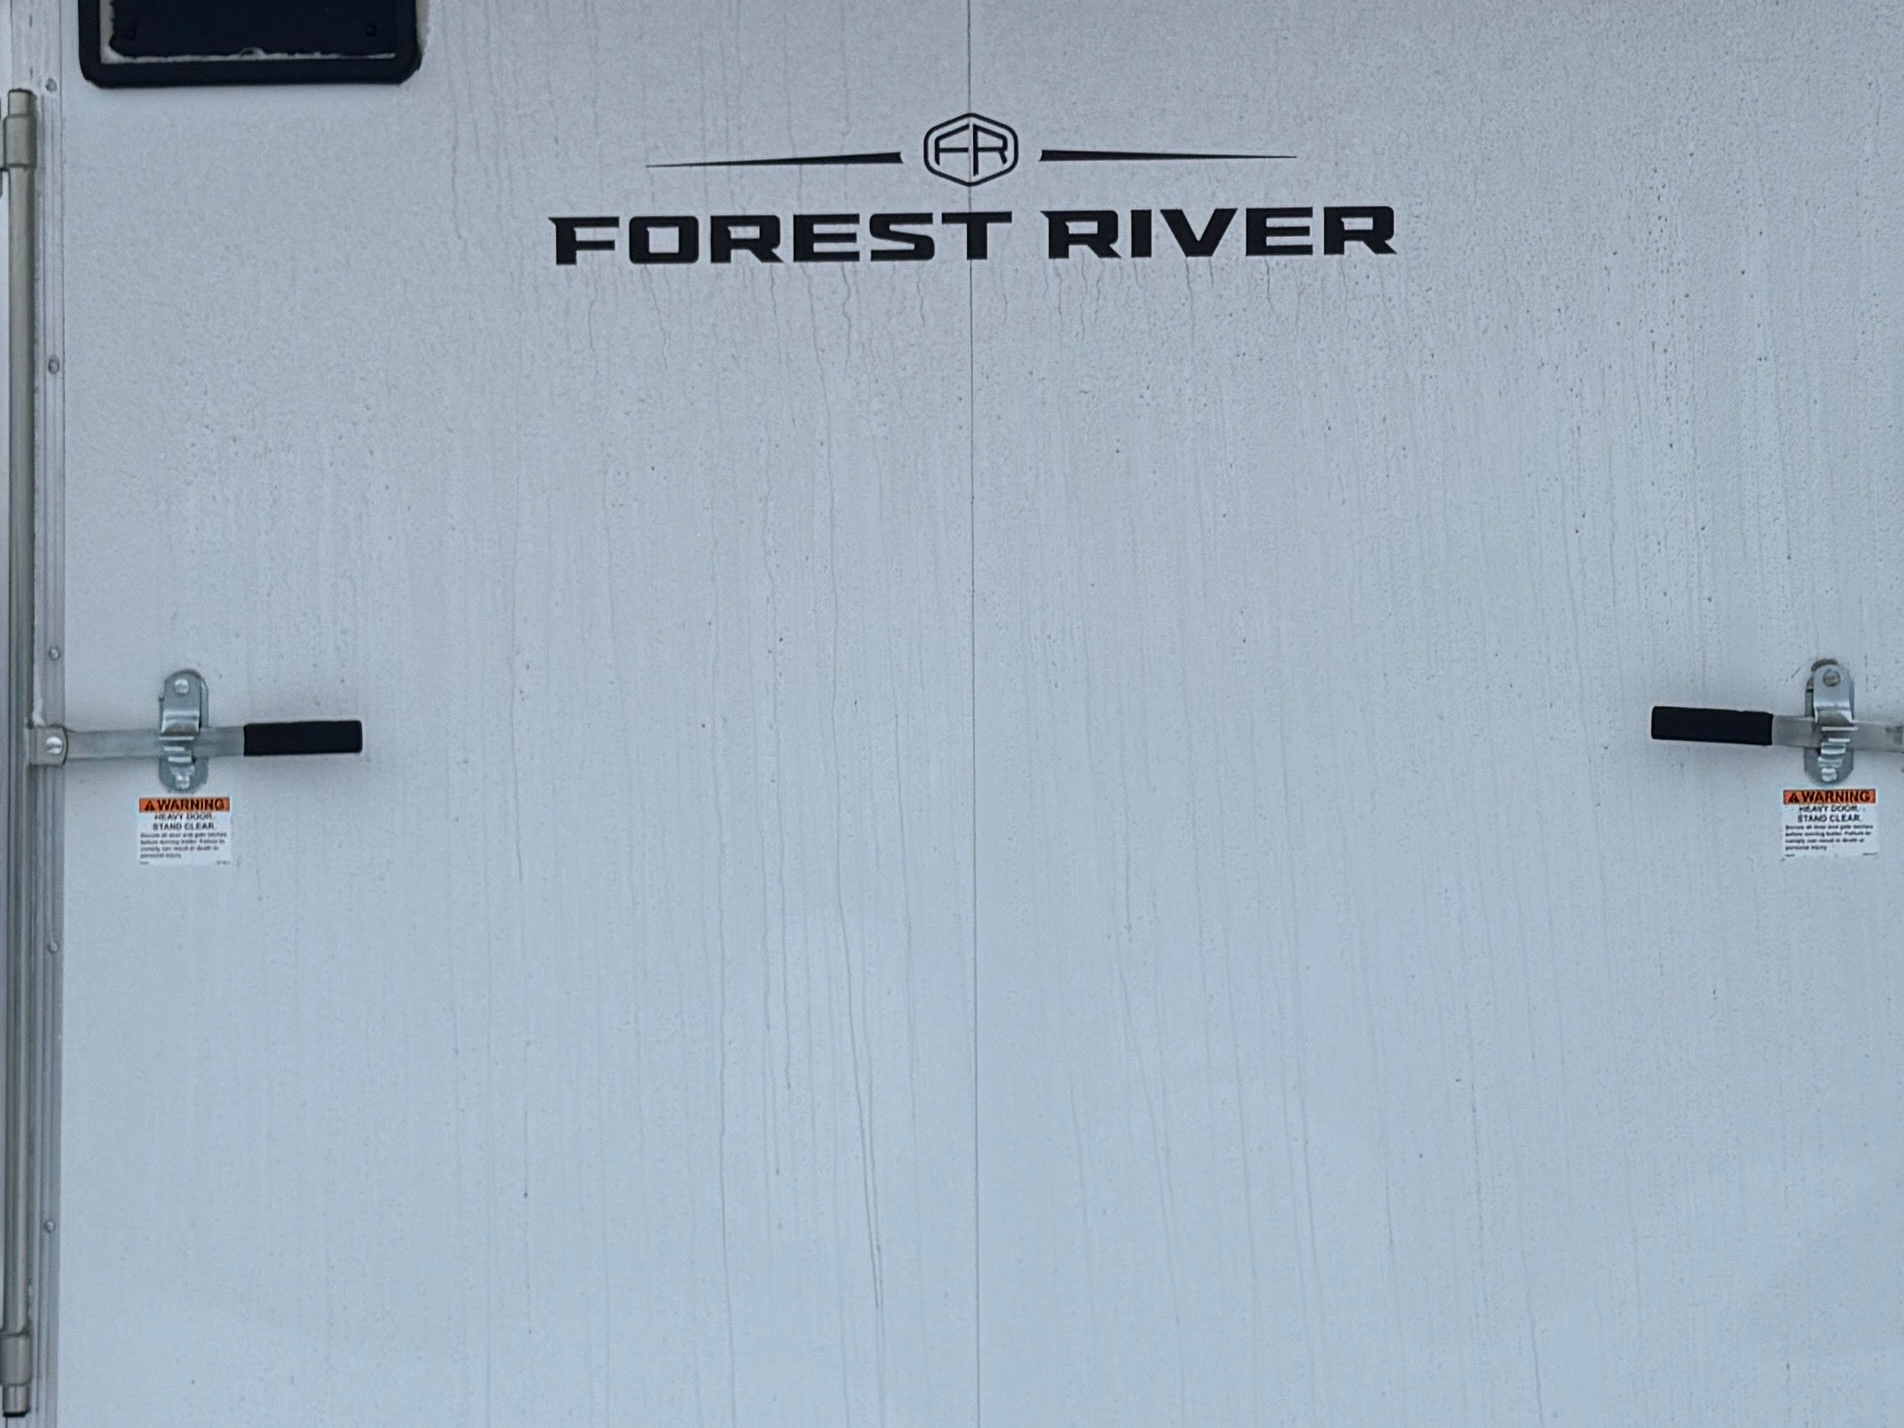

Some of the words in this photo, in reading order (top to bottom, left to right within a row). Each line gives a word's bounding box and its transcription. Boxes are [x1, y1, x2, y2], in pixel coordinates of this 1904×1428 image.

[548, 211, 1013, 266] FOREST
[1041, 205, 1398, 260] RIVER
[1801, 789, 1871, 804] WARNING
[157, 797, 225, 812] WARNING
[1797, 814, 1827, 823] STAND
[152, 822, 182, 831] STAND
